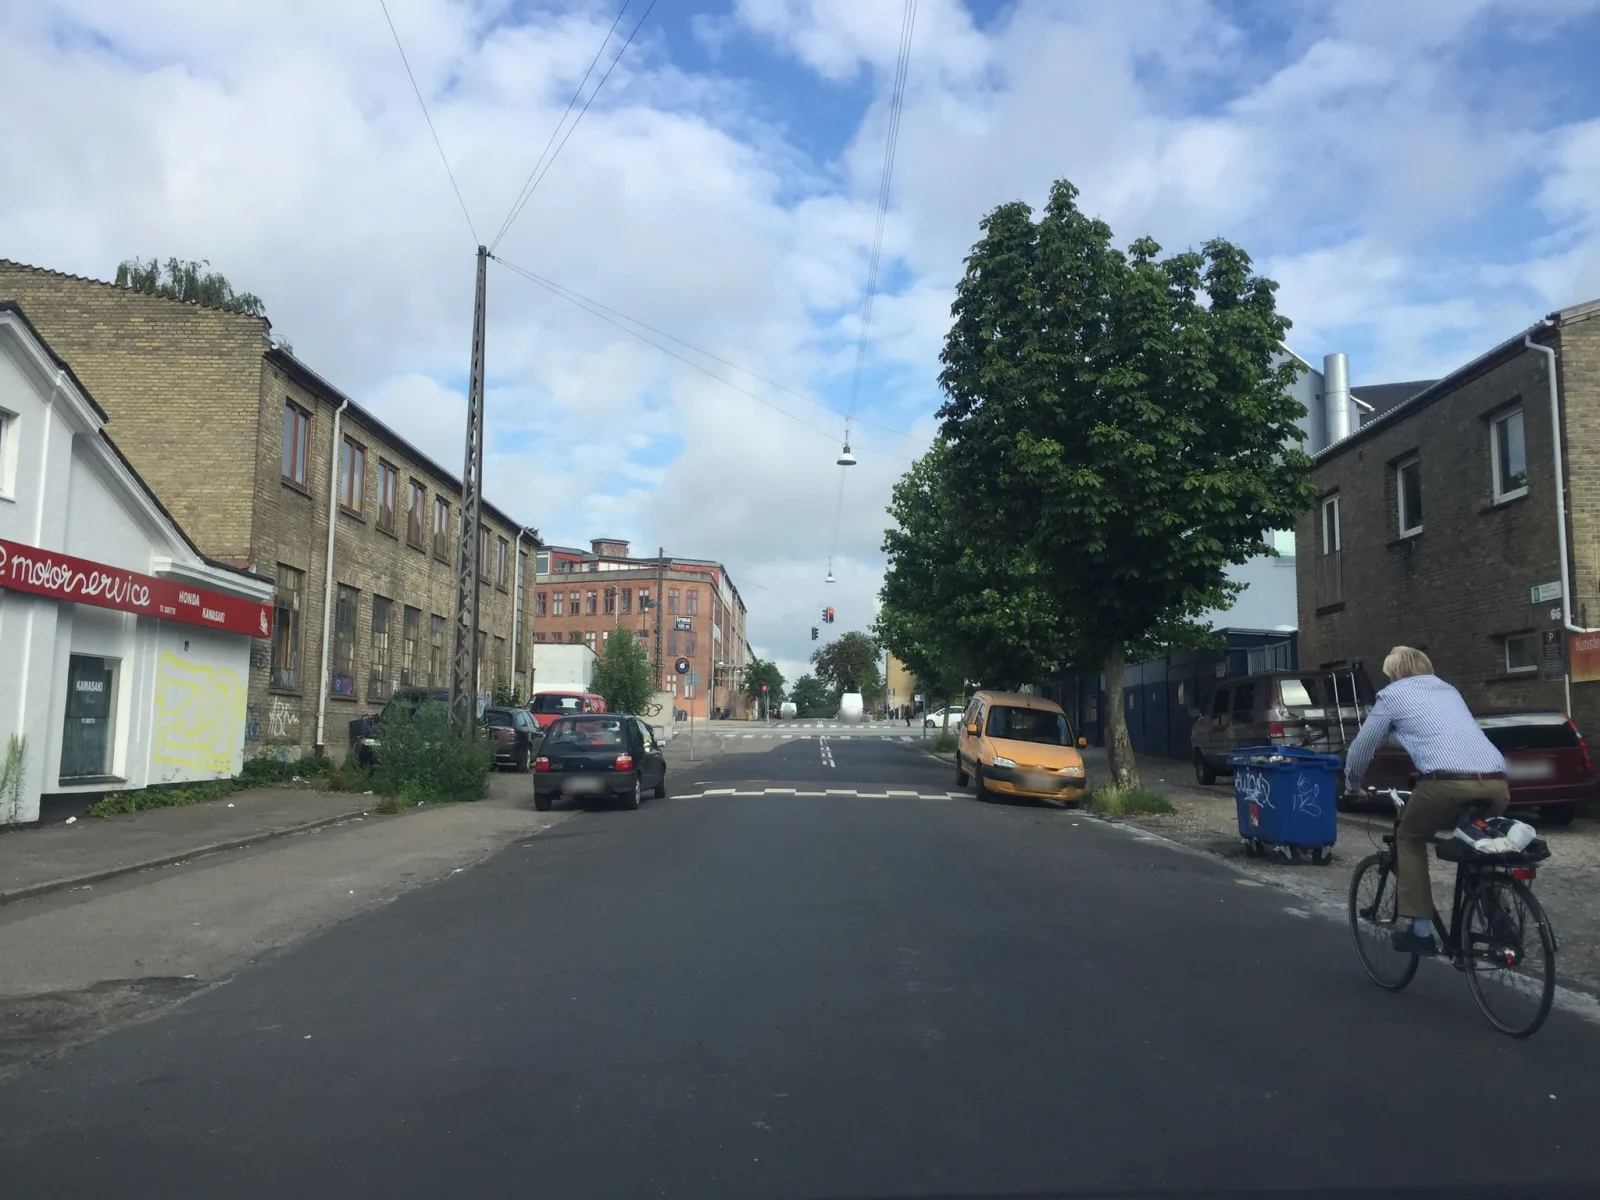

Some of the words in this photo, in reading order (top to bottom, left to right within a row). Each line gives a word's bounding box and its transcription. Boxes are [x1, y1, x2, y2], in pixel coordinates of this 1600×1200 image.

[11, 553, 151, 607] motorservice
[178, 590, 200, 607] HONDA
[201, 607, 226, 623] KAWASAKI
[1550, 607, 1562, 620] 66
[75, 680, 104, 692] KAWASAKI
